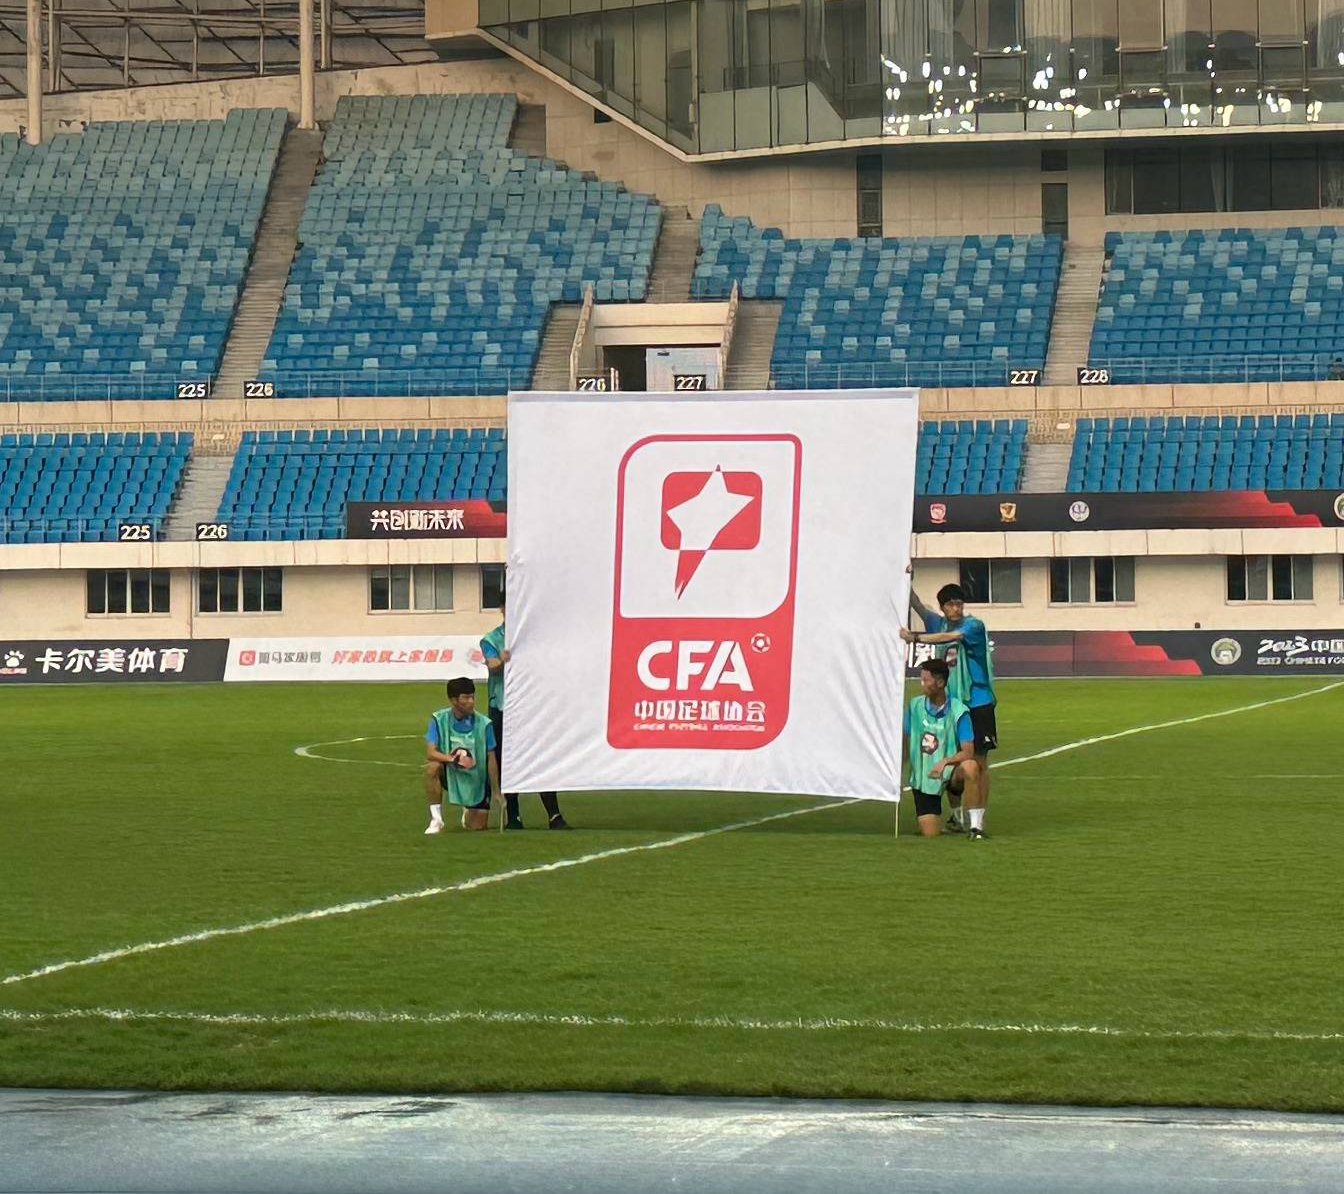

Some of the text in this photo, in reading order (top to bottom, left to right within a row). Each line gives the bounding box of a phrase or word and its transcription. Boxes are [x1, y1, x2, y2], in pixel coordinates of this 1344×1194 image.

[676, 376, 704, 390] 227
[1010, 370, 1038, 385] 227
[1079, 368, 1109, 384] 228
[178, 383, 206, 398] 225
[246, 382, 274, 397] 226
[120, 524, 151, 540] 225
[198, 524, 228, 540] 226
[35, 647, 189, 674] 卡尔美体育
[636, 640, 754, 692] CFA
